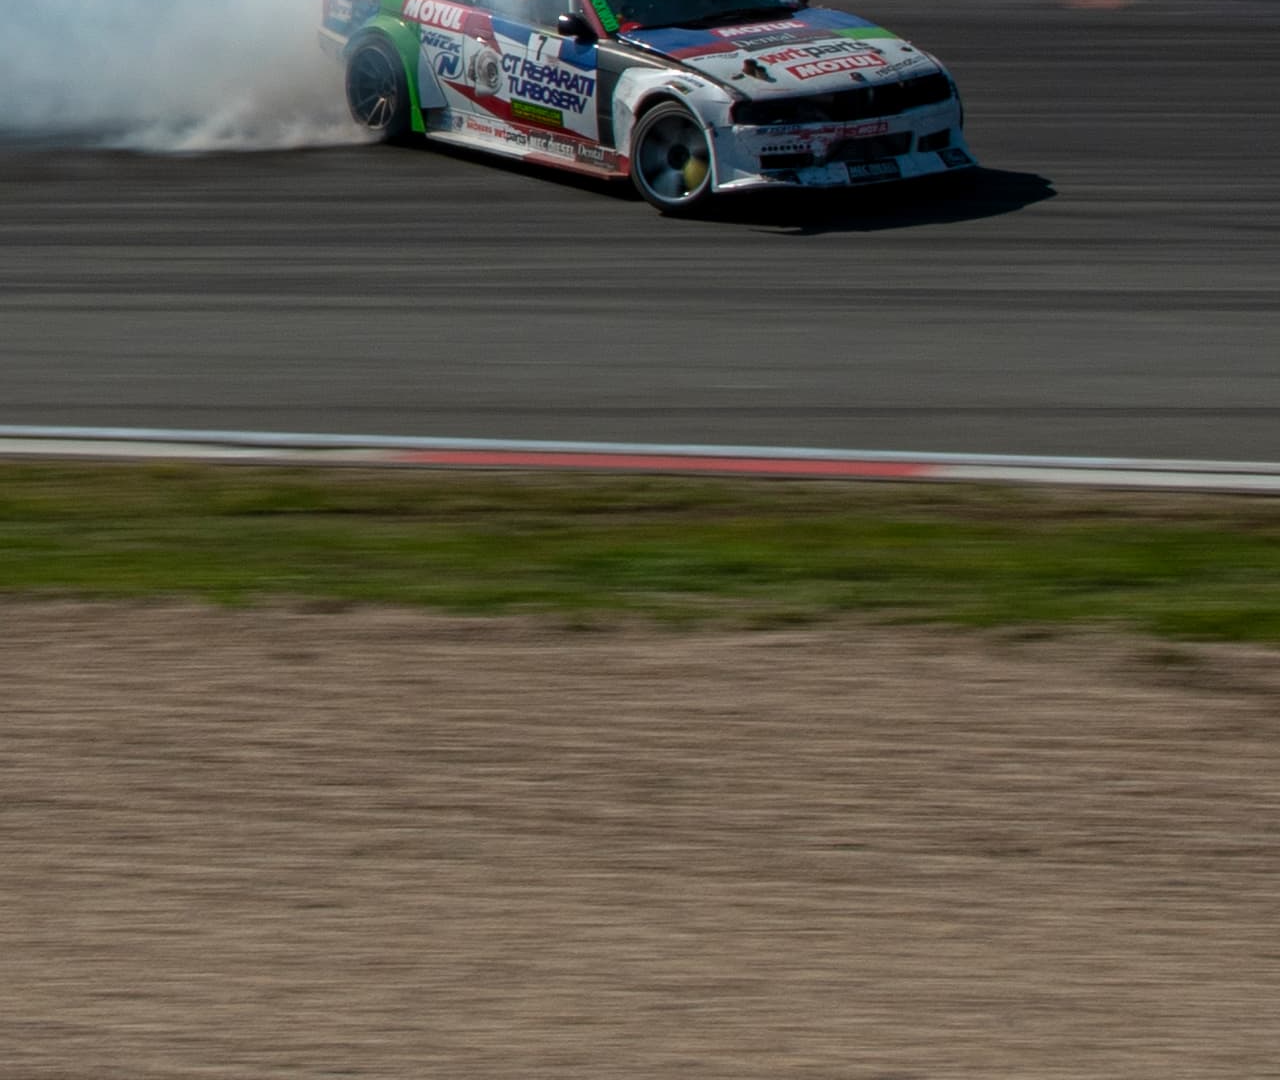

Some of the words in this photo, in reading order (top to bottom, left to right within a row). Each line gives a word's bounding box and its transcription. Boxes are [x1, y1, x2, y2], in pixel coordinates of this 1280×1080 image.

[718, 21, 805, 38] MOTUL
[536, 35, 548, 61] 7
[502, 53, 521, 75] CT
[520, 58, 595, 97] REPARATI
[795, 54, 883, 78] MOTUL
[508, 75, 587, 114] TURBOSERV
